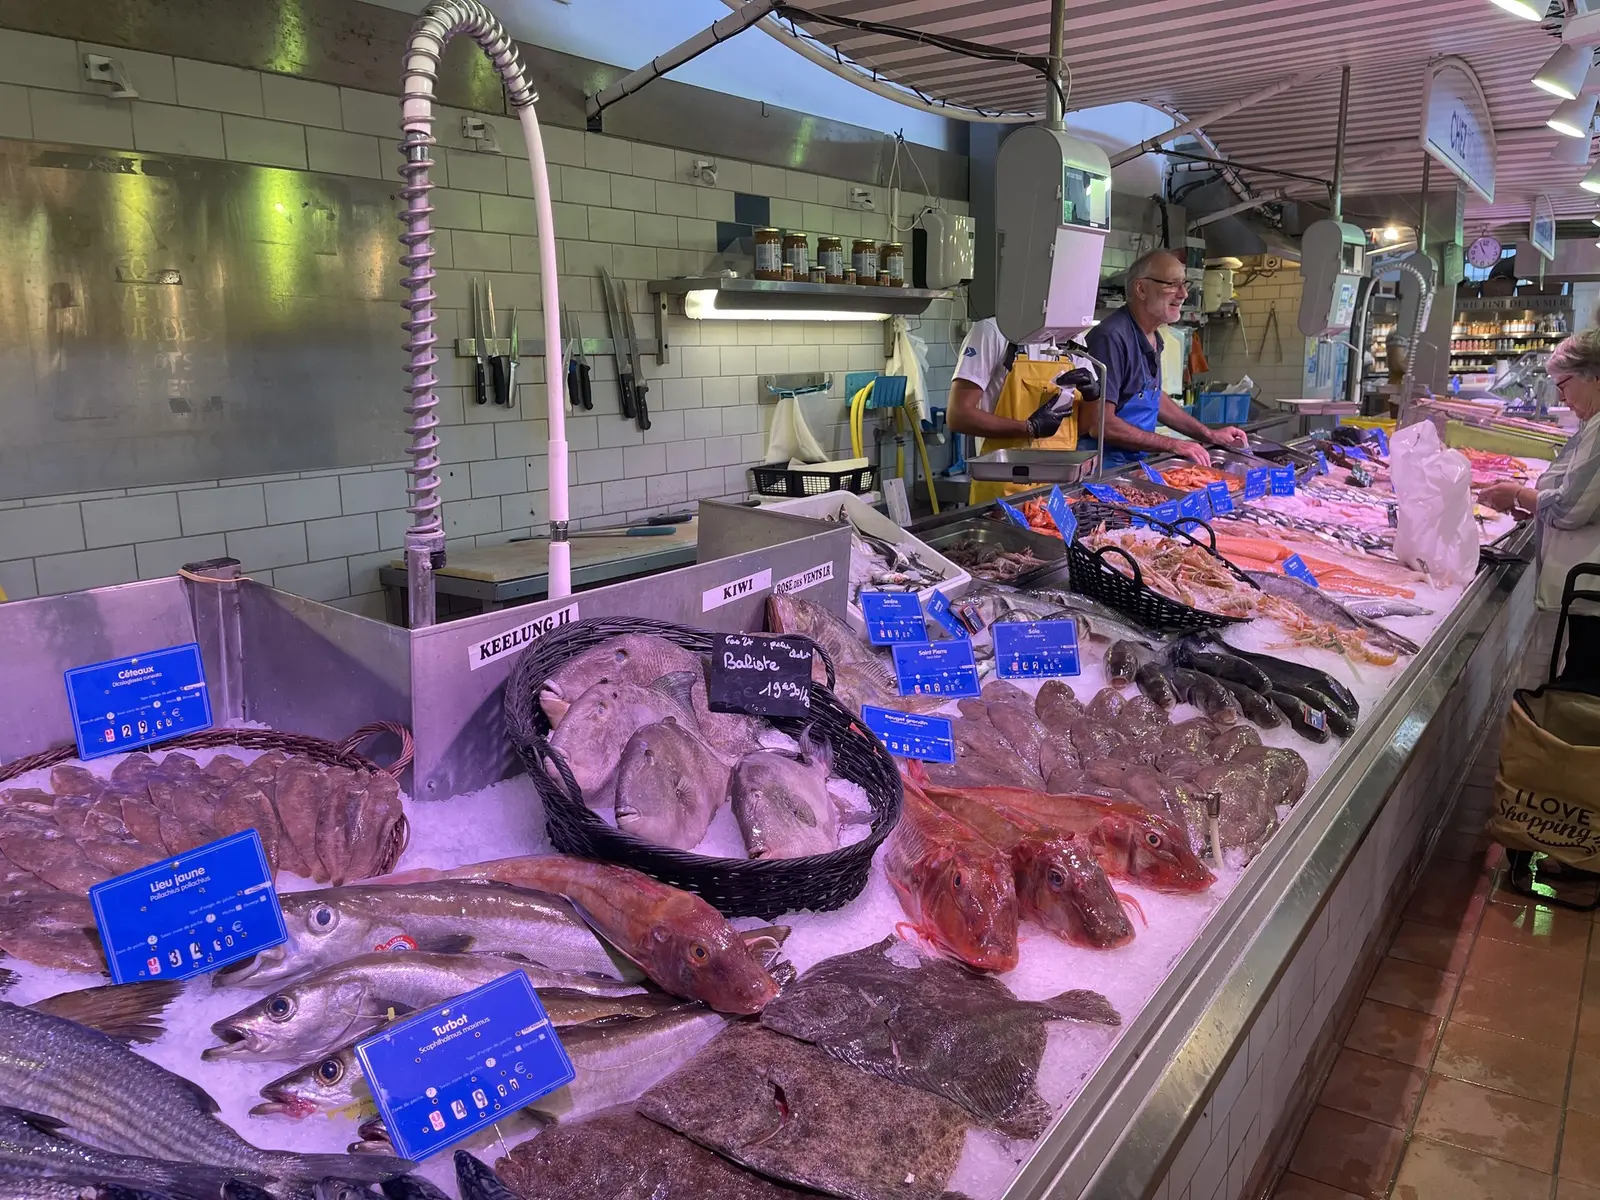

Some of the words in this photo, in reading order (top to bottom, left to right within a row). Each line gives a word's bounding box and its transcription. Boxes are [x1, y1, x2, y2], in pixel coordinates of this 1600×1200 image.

[1450, 109, 1468, 159] CHEZ
[723, 578, 753, 600] KIWI
[776, 579, 793, 594] ROSE
[803, 568, 822, 584] VENTS
[480, 616, 554, 660] KEELUNG
[559, 608, 570, 626] II
[723, 651, 780, 671] Baliste
[1515, 788, 1524, 804] I
[1526, 791, 1595, 826] LOVE
[1496, 798, 1592, 844] Shopping
[149, 884, 180, 902] Pollachius
[180, 875, 212, 893] pollachius
[150, 876, 174, 893] Lieu
[174, 866, 205, 884] jaune
[418, 1029, 462, 1054] Scophthalmus
[462, 1016, 490, 1034] maximus
[432, 1014, 468, 1036] Turbot
